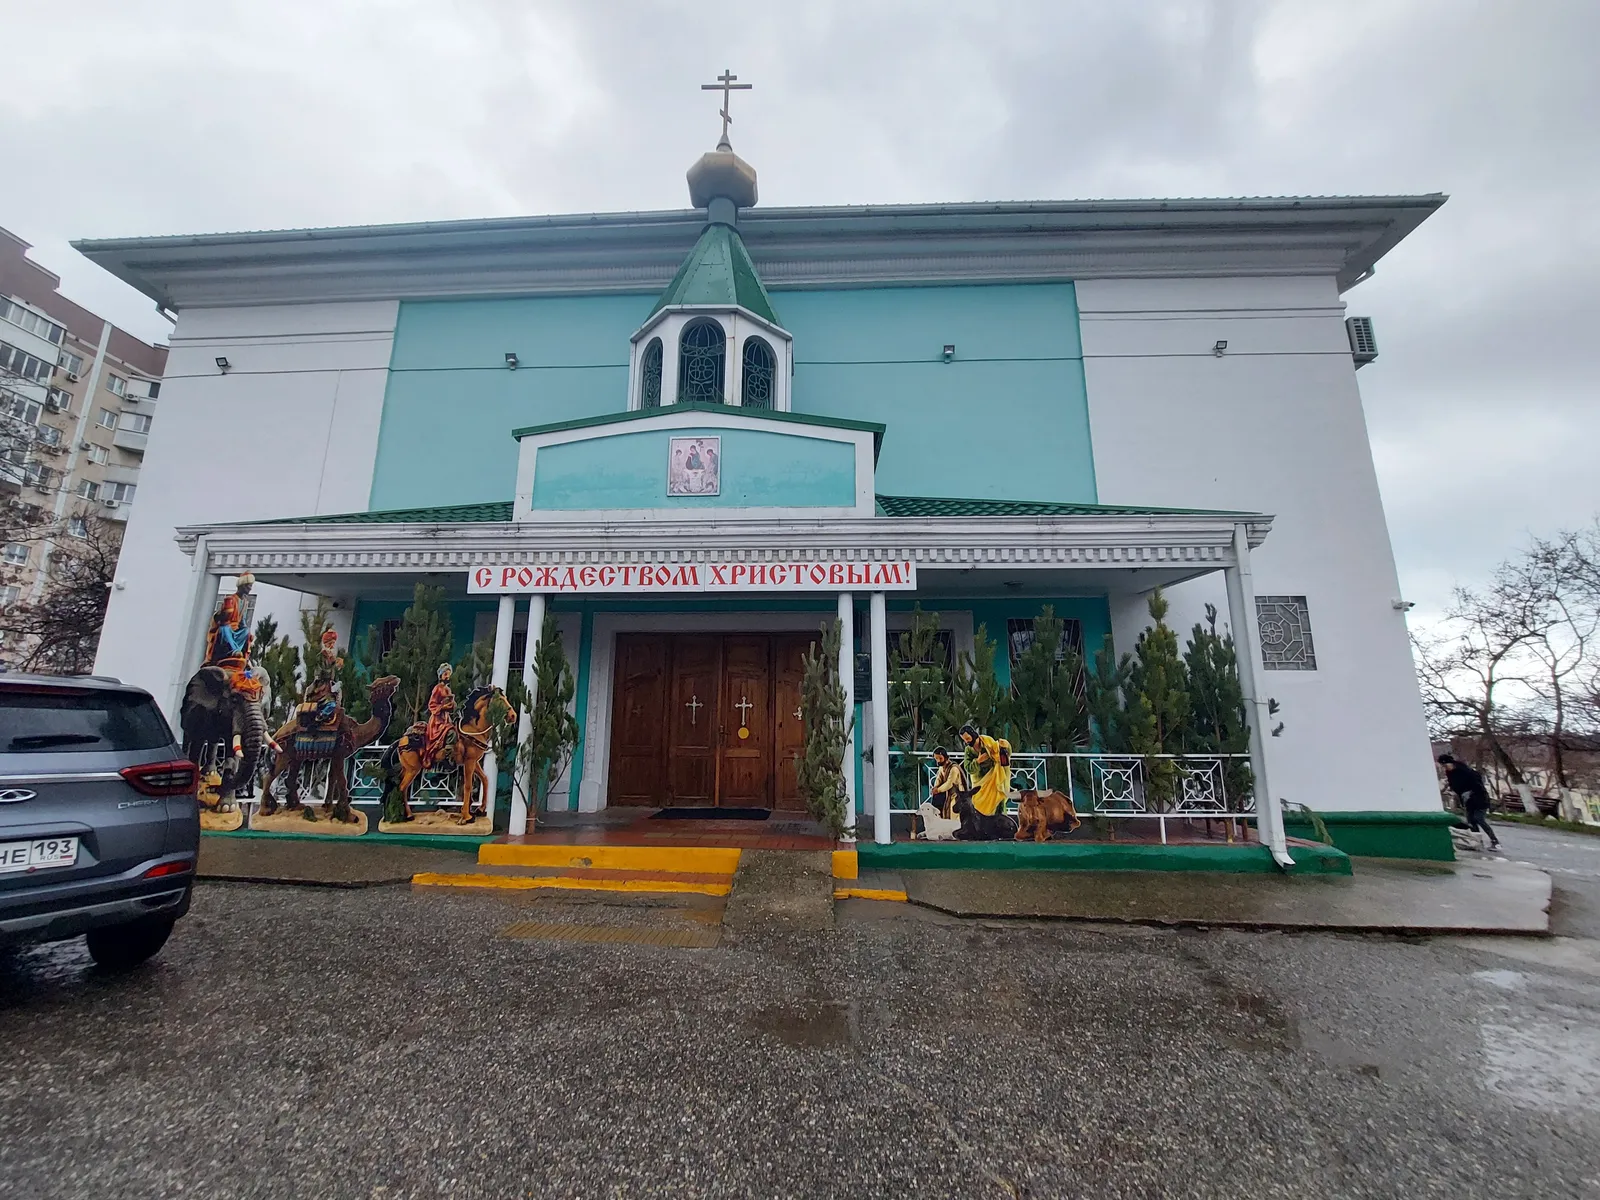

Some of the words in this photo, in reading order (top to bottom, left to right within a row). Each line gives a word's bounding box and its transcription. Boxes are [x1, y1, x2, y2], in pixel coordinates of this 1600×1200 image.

[475, 567, 493, 588] С
[499, 565, 701, 591] РОЖДЕСТВОМ
[708, 561, 911, 586] ХРИСТОВЫМ!
[34, 839, 72, 856] 193
